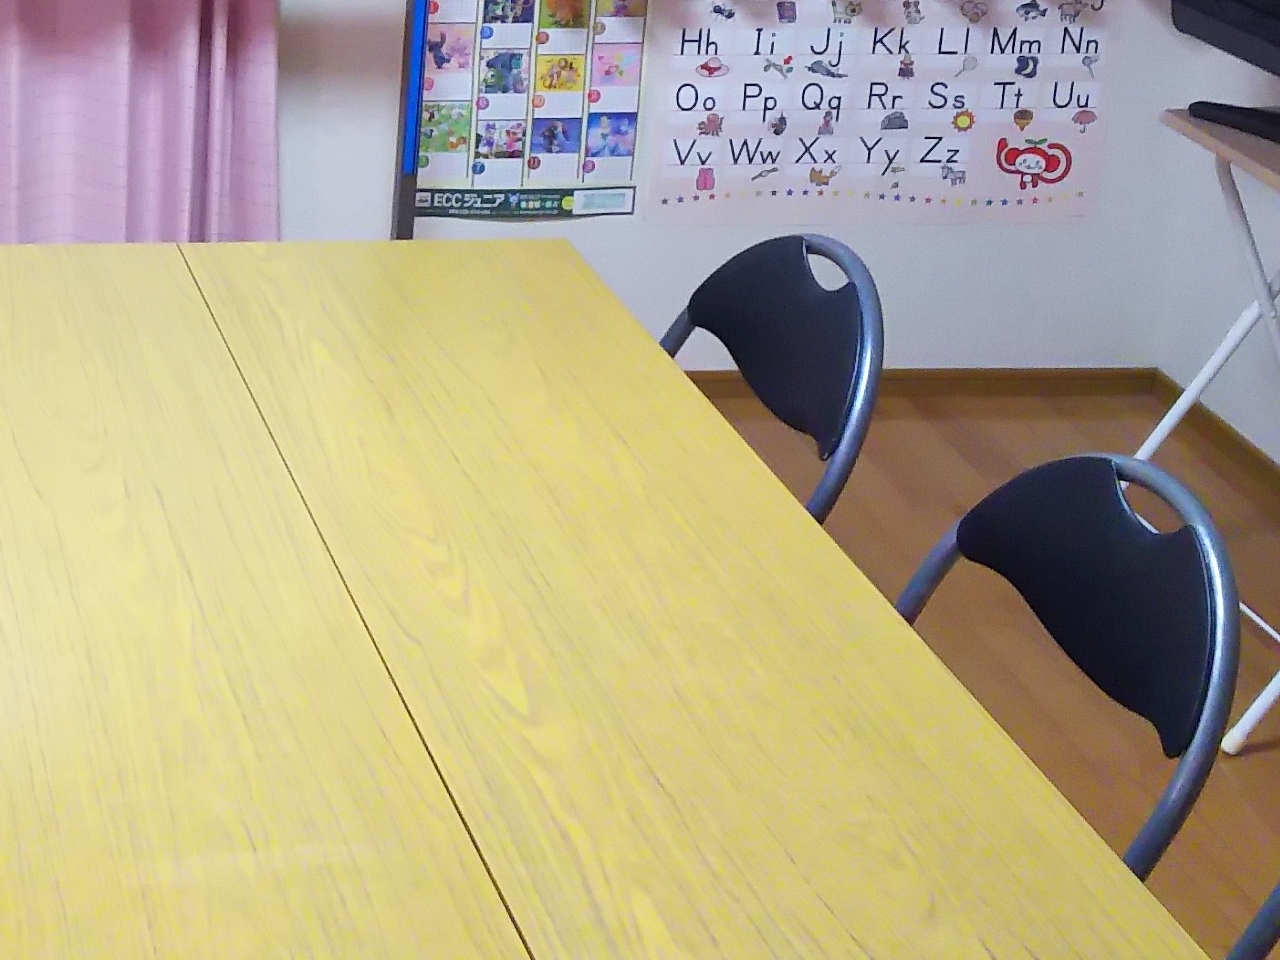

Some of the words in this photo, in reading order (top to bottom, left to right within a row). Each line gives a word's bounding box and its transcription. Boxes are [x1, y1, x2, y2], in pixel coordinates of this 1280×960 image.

[680, 27, 719, 56] Hh
[754, 27, 776, 56] Ii
[810, 27, 845, 68] Jj
[872, 27, 910, 55] Kk
[938, 27, 971, 55] Ll
[990, 26, 1042, 55] Mm
[1061, 26, 1099, 55] Nn
[676, 83, 716, 112] Oo
[742, 83, 778, 123] Pp
[801, 83, 842, 123] Qq
[867, 82, 904, 110] Rr
[928, 81, 966, 110] Ss
[993, 81, 1023, 110] Tt
[1052, 81, 1090, 109] Uu
[673, 138, 713, 166] Vv
[728, 137, 781, 166] Ww
[795, 136, 837, 165] Xx
[859, 136, 900, 177] Yy
[920, 136, 960, 164] Zz
